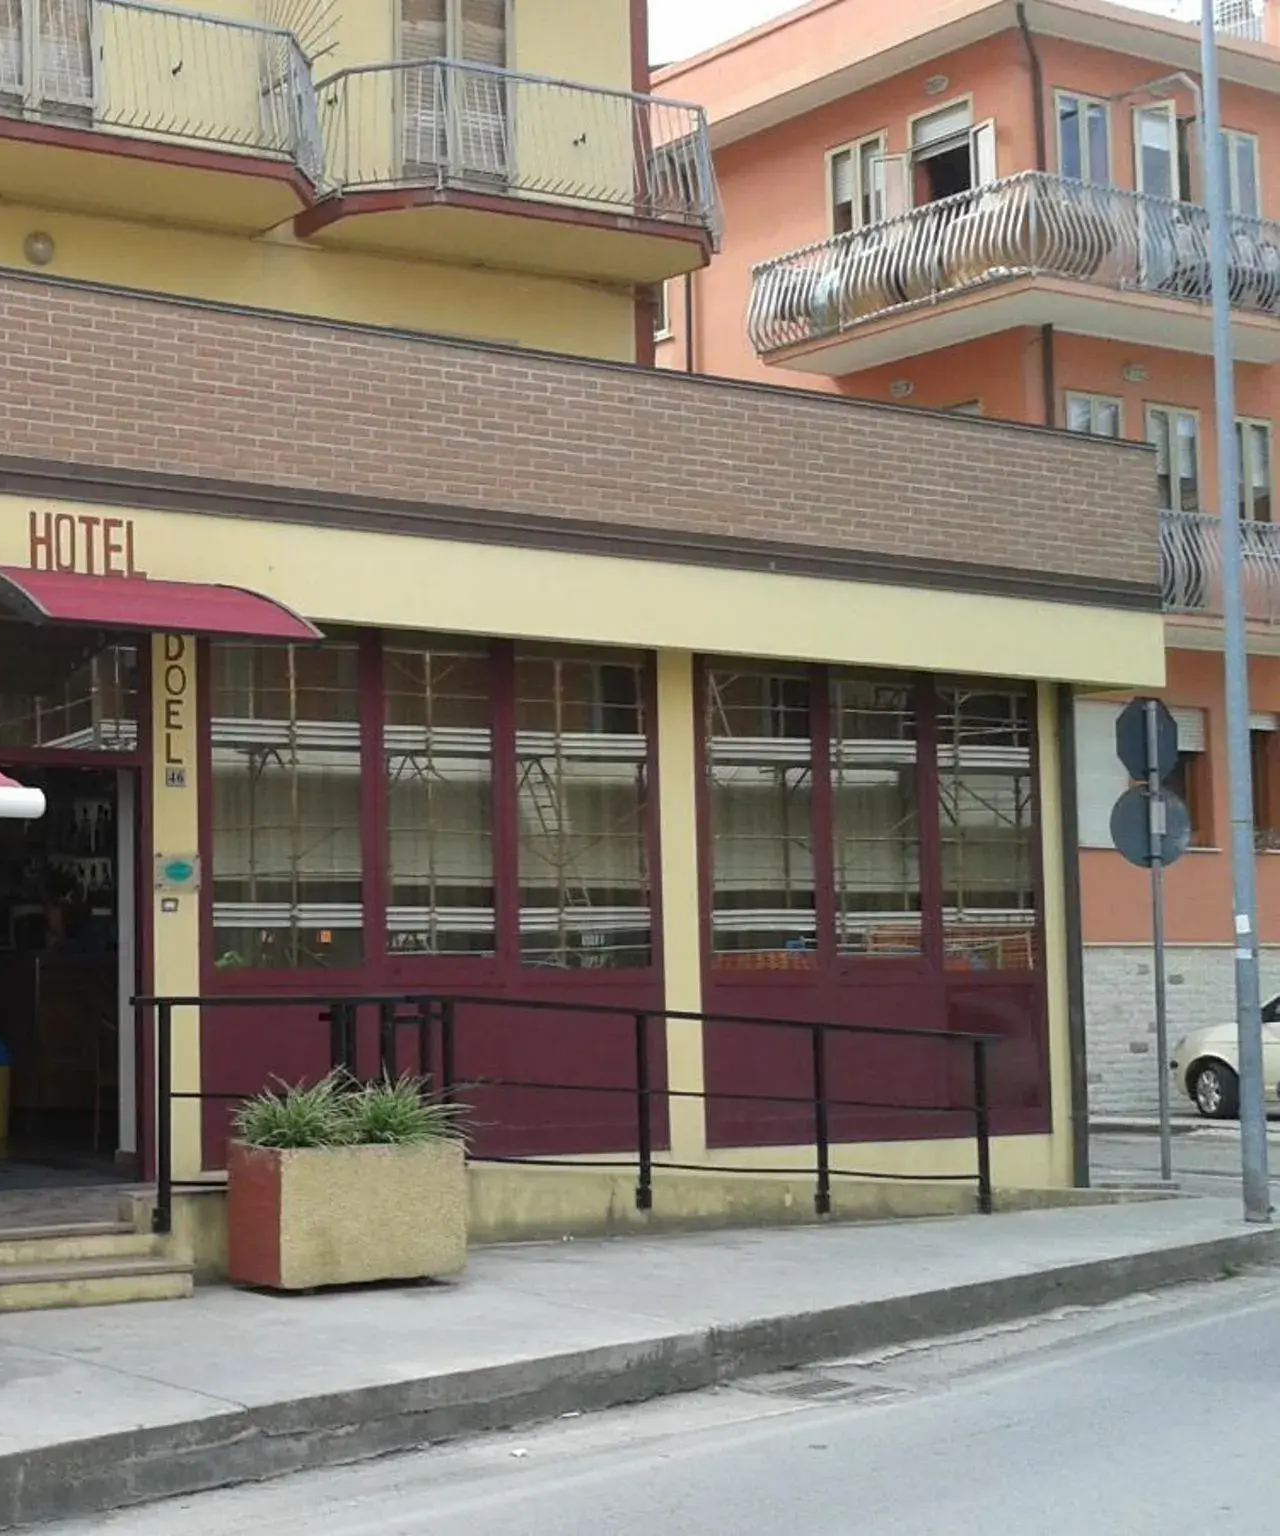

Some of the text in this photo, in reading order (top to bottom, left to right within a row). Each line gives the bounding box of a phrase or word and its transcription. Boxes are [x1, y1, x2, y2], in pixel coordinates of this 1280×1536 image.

[29, 510, 147, 581] HOTEL
[164, 633, 187, 764] DOEL
[167, 770, 185, 785] 46
